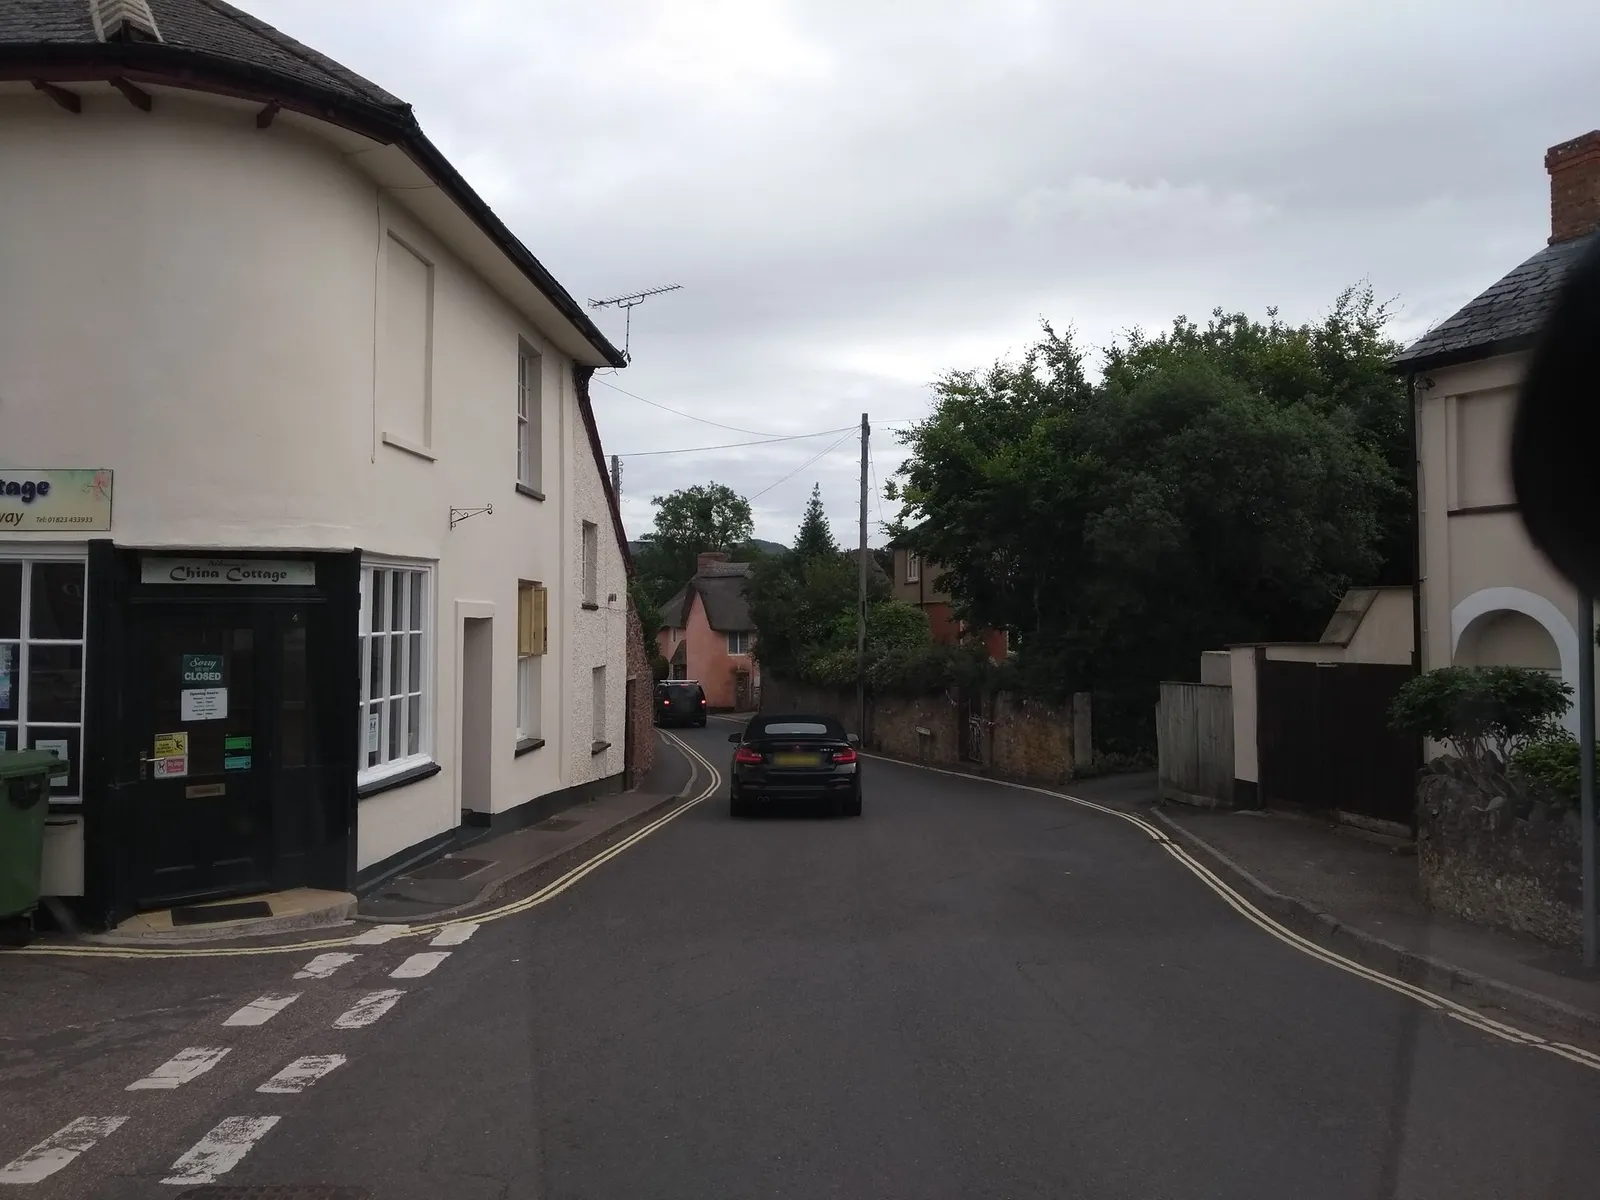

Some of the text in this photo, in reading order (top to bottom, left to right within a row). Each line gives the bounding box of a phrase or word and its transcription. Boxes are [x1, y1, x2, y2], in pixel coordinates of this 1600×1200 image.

[169, 566, 287, 582] China Cottage
[189, 657, 217, 670] Sorry
[184, 672, 221, 681] CLOSED
